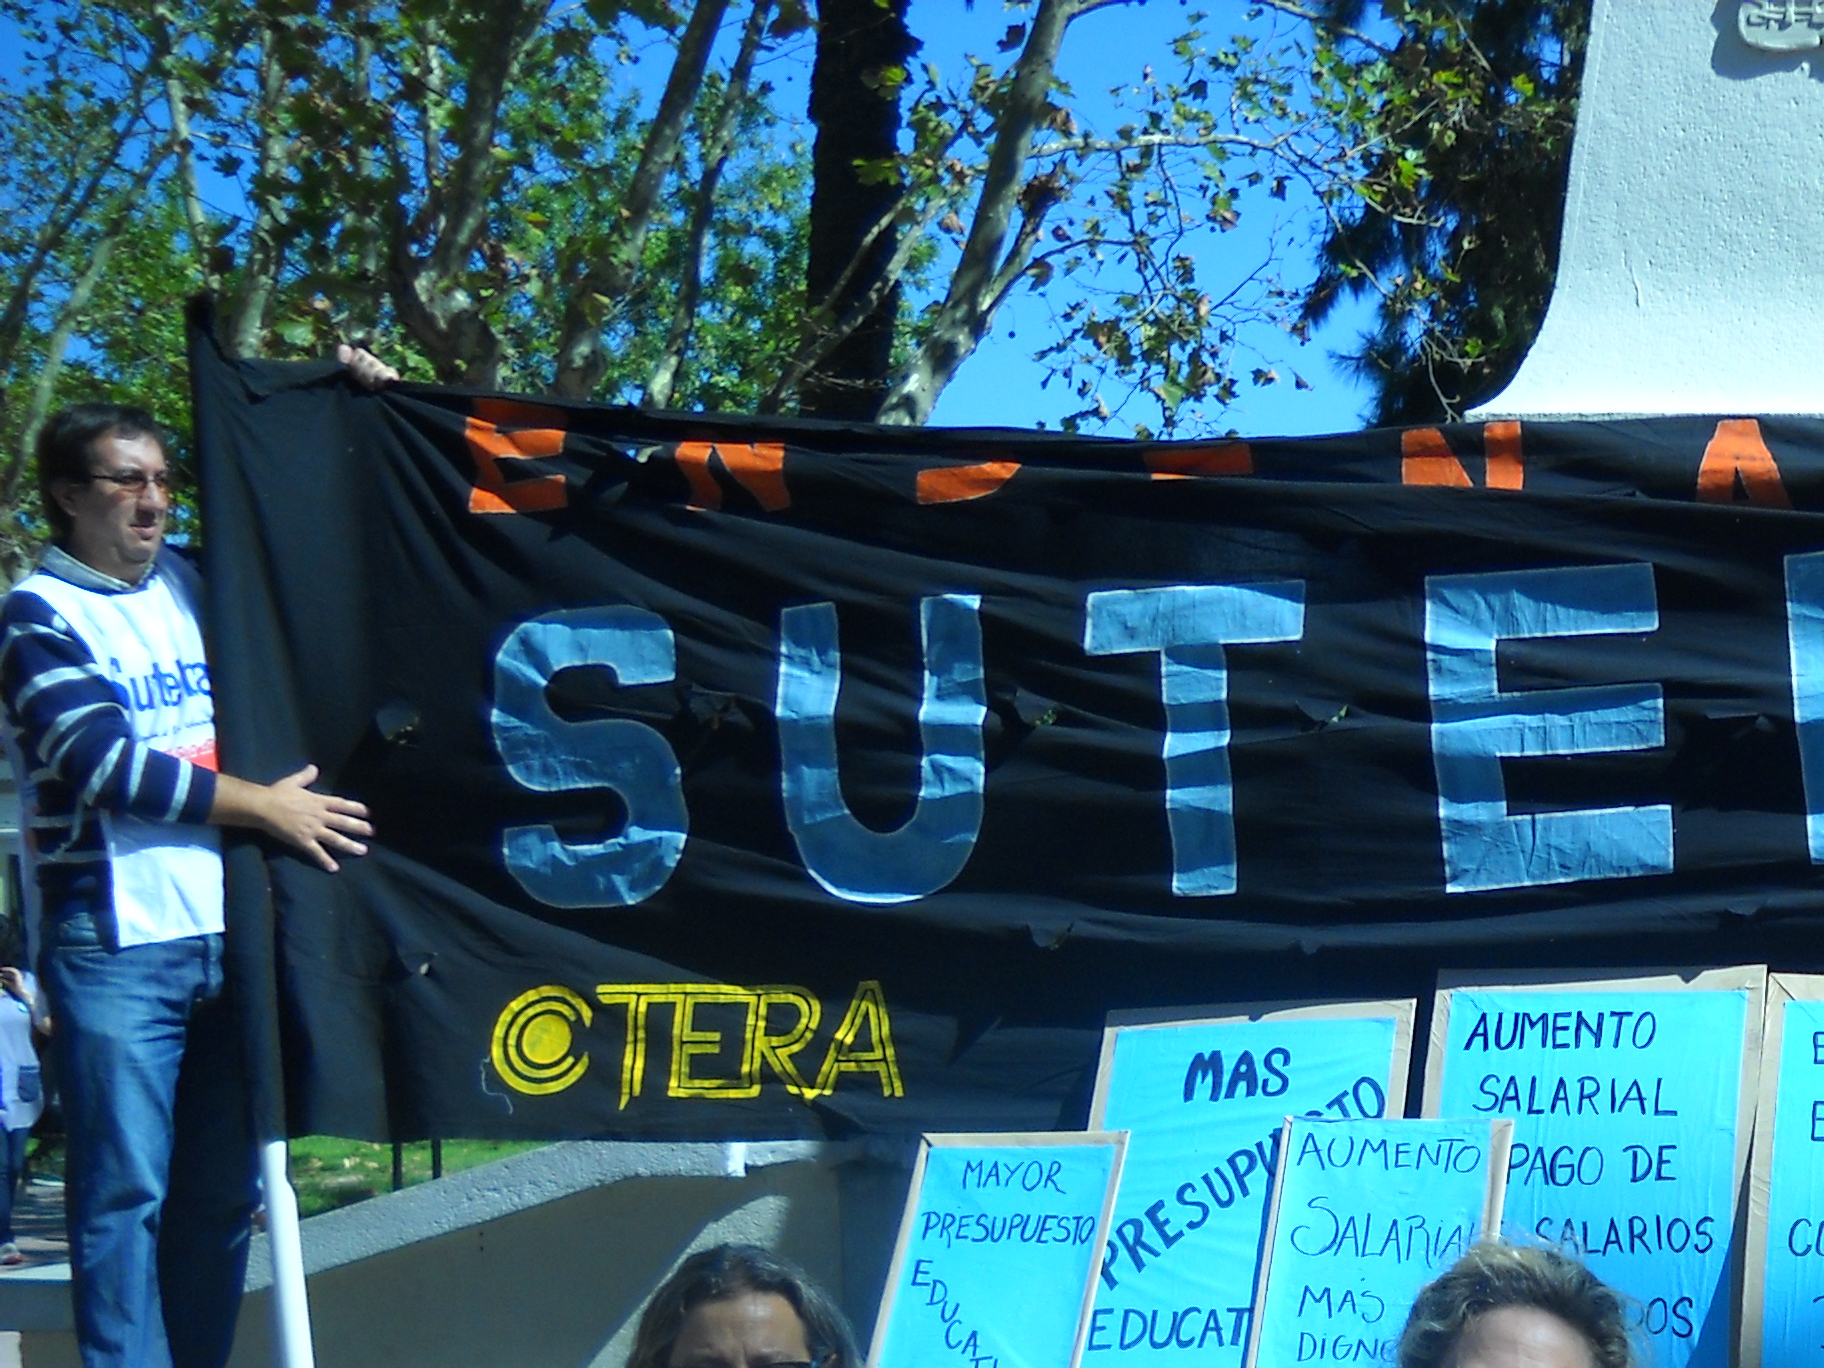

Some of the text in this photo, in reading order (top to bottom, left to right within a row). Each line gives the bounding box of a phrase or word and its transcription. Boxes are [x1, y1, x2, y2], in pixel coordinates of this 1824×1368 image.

[490, 980, 905, 1111] CTERA
[1463, 1010, 1657, 1052] AUMENTO
[1184, 1047, 1292, 1104] MAS
[1473, 1074, 1678, 1117] SALARIAL
[1296, 1131, 1482, 1174] AUMENTO
[1506, 1142, 1678, 1187] PAGO DE
[962, 1159, 1067, 1195] MAYOR
[1098, 1075, 1386, 1292] PRESUPUTO
[922, 1210, 1096, 1249] PRESUPUESTO
[1534, 1213, 1716, 1257] SALARIOS
[1088, 1307, 1255, 1353] EDUCAT
